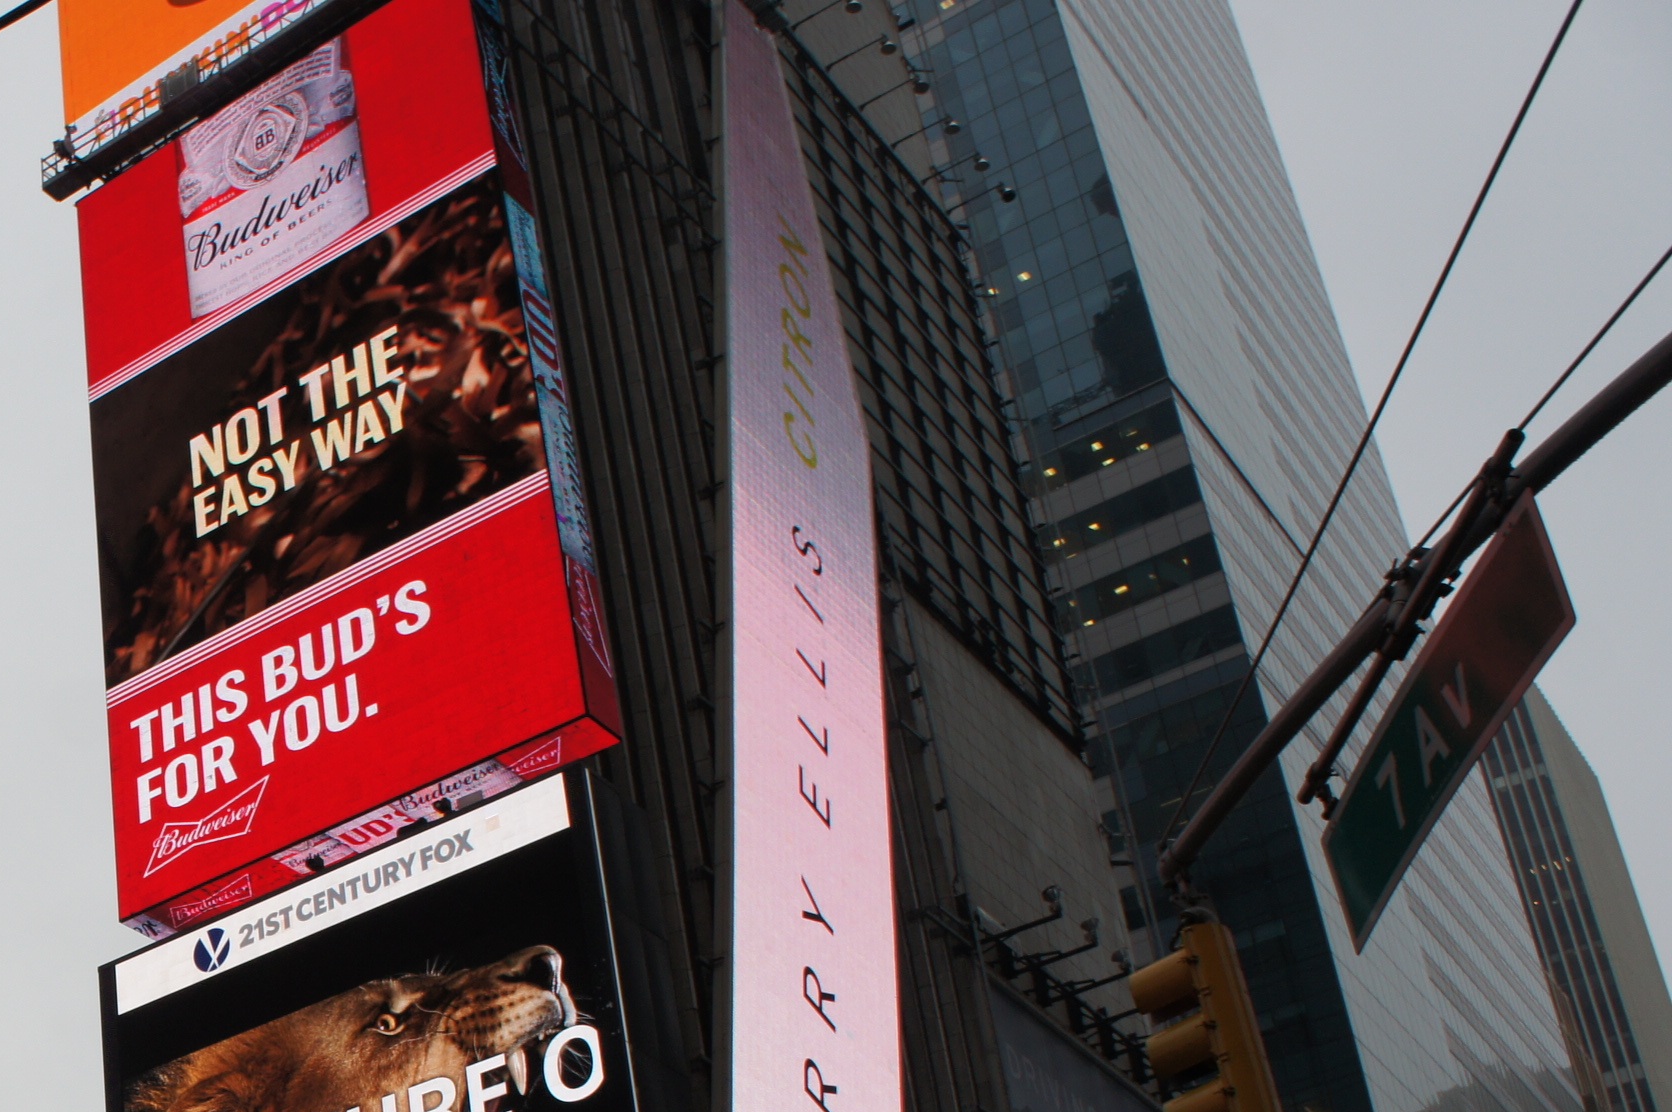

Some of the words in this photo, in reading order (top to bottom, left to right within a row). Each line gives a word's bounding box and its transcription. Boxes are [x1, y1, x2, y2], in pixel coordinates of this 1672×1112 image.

[188, 150, 359, 271] Budweiser
[220, 247, 254, 270] KING
[260, 230, 280, 247] OF
[287, 199, 333, 231] BEERS
[189, 387, 287, 488] NOT
[299, 326, 405, 425] THE
[776, 208, 820, 470] CITRON
[194, 441, 299, 538] EASY
[310, 383, 407, 473] WAY
[131, 669, 249, 763] THIS
[261, 580, 431, 703] BUD'S
[791, 523, 832, 830] ELLIS
[136, 735, 238, 824] FOR
[248, 673, 379, 768] YOU.
[397, 761, 500, 814] Budweiser
[1374, 751, 1406, 830] 7
[1413, 660, 1472, 788] AV
[152, 799, 261, 860] Budweiser
[238, 904, 294, 949] 21ST
[294, 854, 418, 923] CENTURY
[420, 829, 475, 872] FOX
[174, 881, 251, 921] Budweiser
[543, 1024, 604, 1102] O
